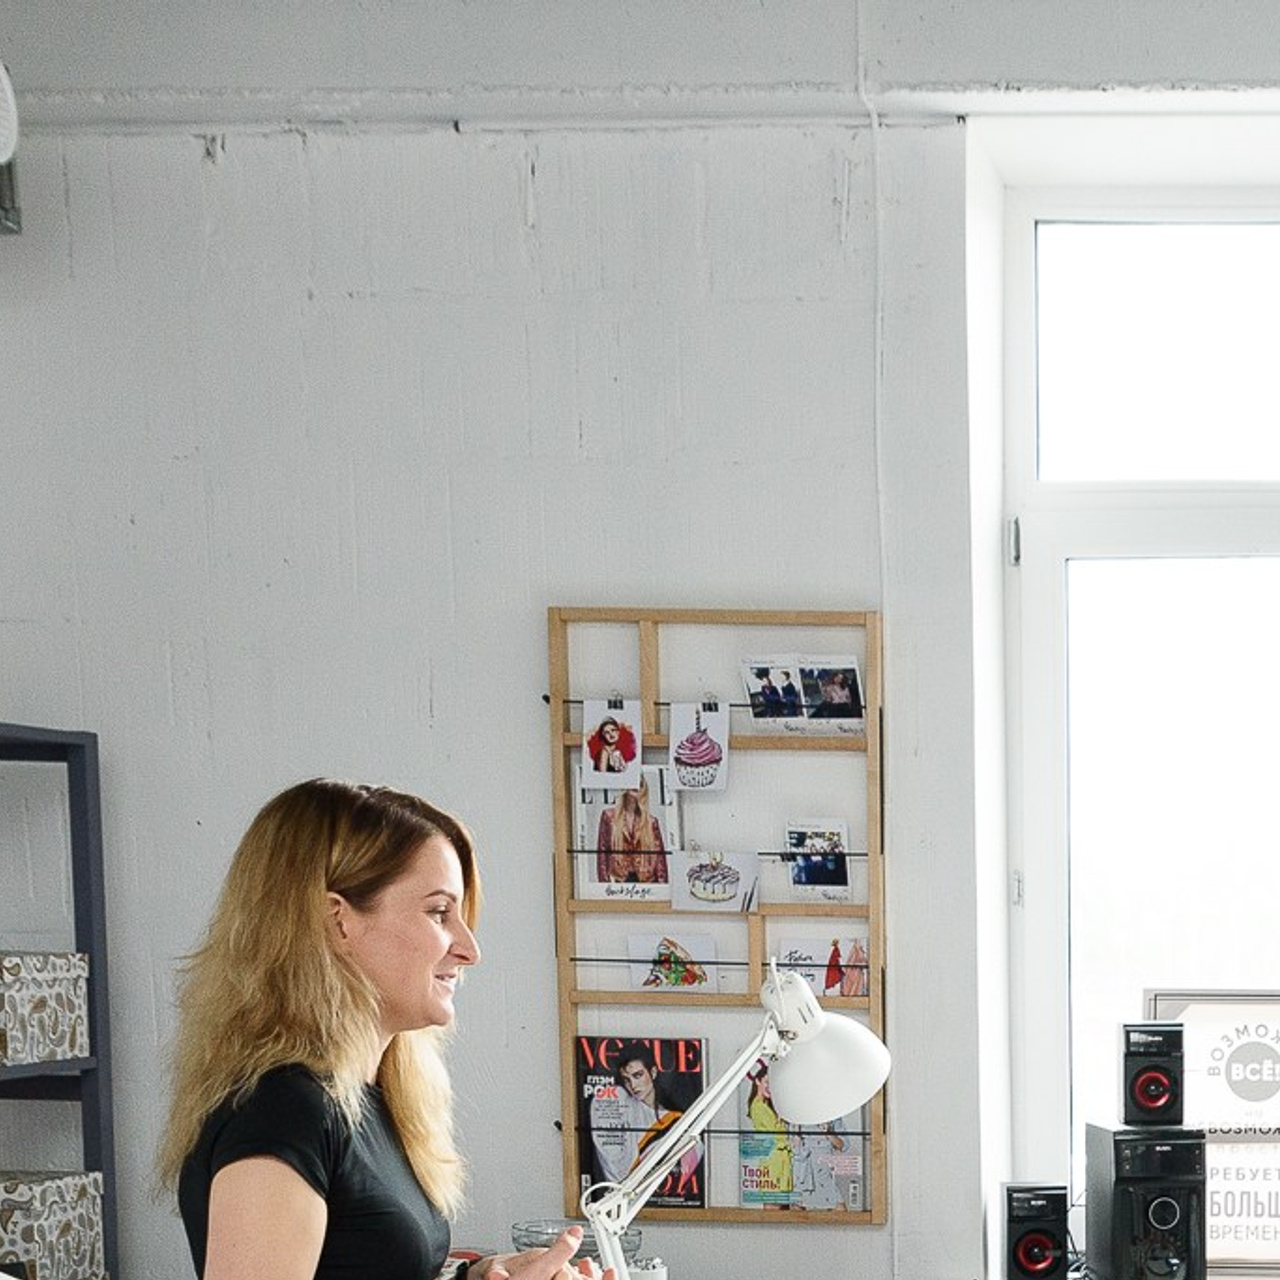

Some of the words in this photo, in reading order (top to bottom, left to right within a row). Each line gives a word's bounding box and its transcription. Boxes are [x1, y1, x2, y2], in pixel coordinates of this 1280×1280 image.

[580, 1037, 700, 1073] VOUE
[1231, 1059, 1280, 1082] ВСЁ!
[583, 1085, 618, 1099] РОК
[742, 1165, 770, 1178] Твой
